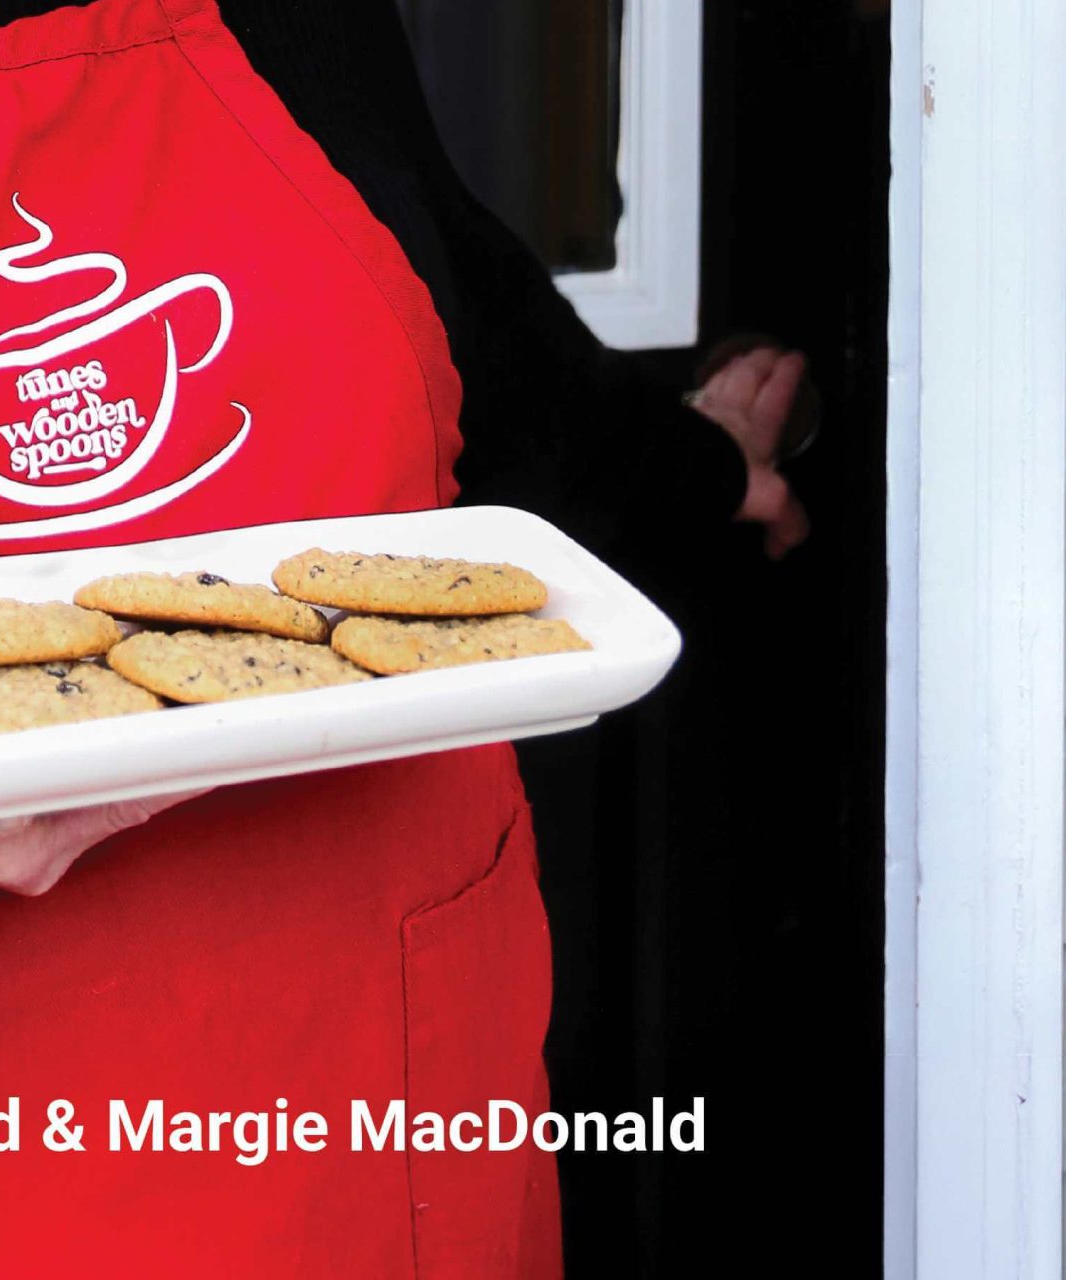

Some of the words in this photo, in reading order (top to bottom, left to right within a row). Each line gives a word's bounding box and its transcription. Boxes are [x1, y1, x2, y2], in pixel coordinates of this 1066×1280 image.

[14, 360, 107, 403] tunes
[50, 390, 79, 411] and
[10, 423, 127, 479] spoons
